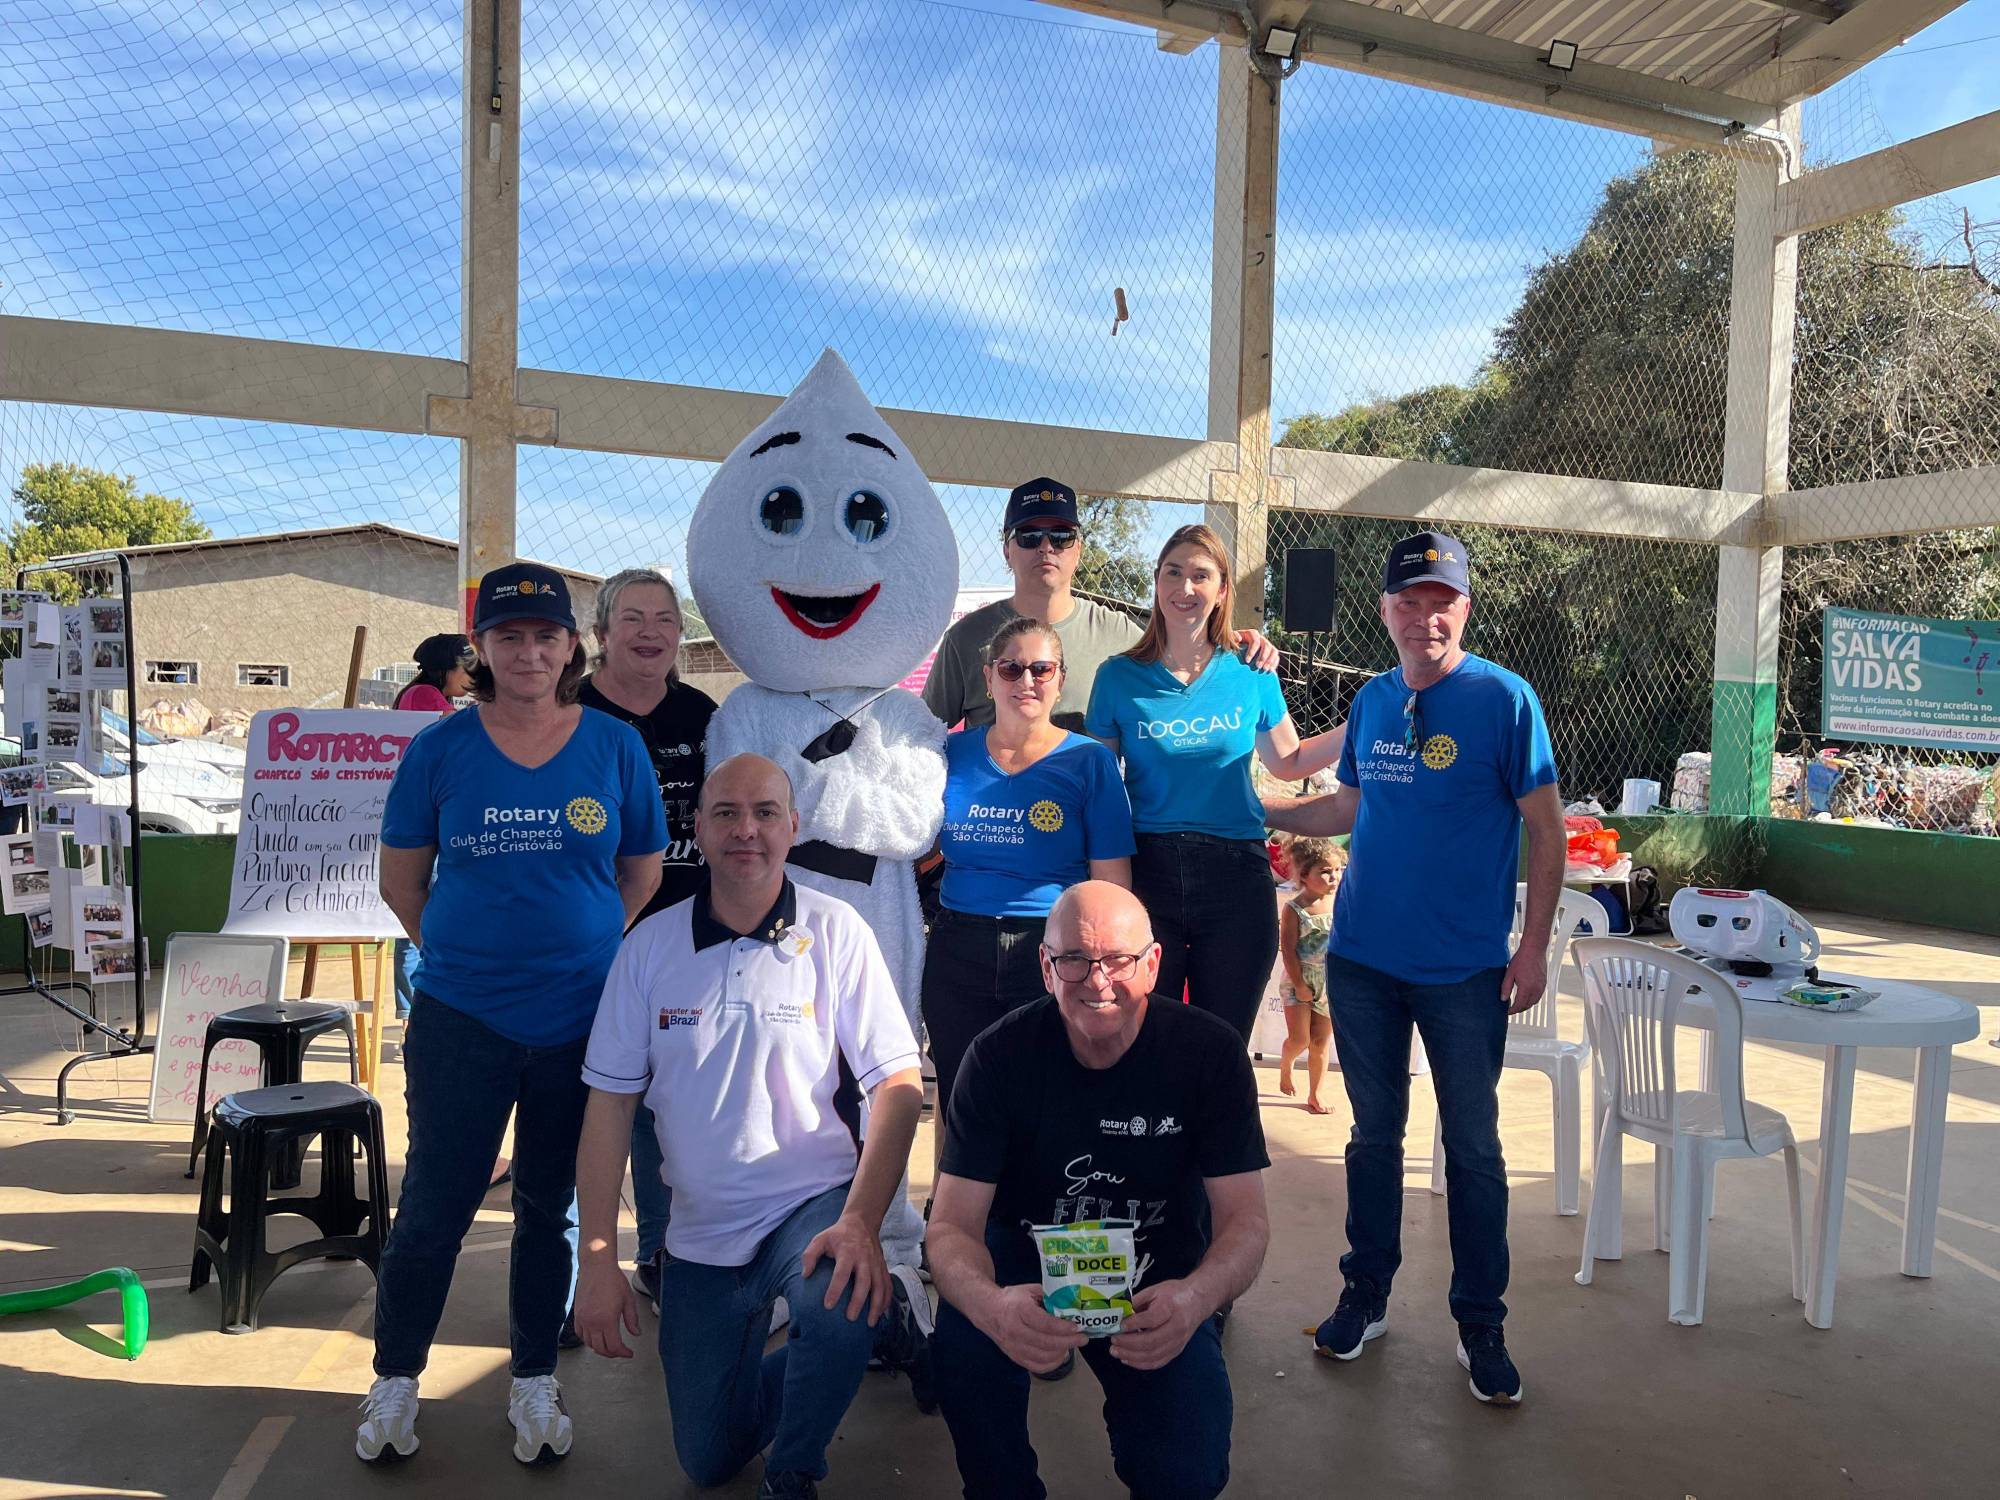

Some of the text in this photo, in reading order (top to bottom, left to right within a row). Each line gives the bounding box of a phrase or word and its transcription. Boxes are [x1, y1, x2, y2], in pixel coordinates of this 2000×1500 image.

[496, 583, 518, 594] Rotary
[1832, 630, 1920, 661] SALVA
[1832, 659, 1922, 692] VIDAS
[1830, 693, 1857, 703] Vacinas
[1861, 694, 1904, 705] funcionam.
[1906, 697, 1912, 706] O
[1914, 699, 1941, 710] Rotary
[1943, 701, 1979, 711] acredita
[1830, 703, 1852, 713] poder
[1854, 705, 1863, 713] da
[1865, 706, 1912, 718] informação
[1934, 711, 1970, 721] combate
[268, 712, 412, 763] ROTARACT
[1834, 721, 2000, 742] www.informacaosalvavidas.com.br
[1371, 740, 1417, 760] Rotary
[254, 767, 303, 780] CHAPECÓ
[311, 767, 330, 781] SÃO
[1366, 760, 1376, 769] de
[1376, 760, 1415, 773] Chapecó
[1360, 771, 1414, 784] São Cristóvão
[484, 806, 560, 825] Rotary
[967, 804, 1025, 822] Rotary
[246, 823, 299, 852] Ajuda
[304, 843, 322, 852] com
[326, 843, 342, 851] seu
[450, 826, 563, 848] Club de Chapecó
[943, 822, 1025, 835] Club de Chapecó
[952, 832, 1025, 844] São Cristóvão
[471, 840, 563, 857] São Cristóvão
[240, 852, 378, 883] Pintura facial
[239, 884, 279, 912] Zé
[178, 961, 270, 998] Venha
[670, 1014, 700, 1026] Brazil
[1100, 1119, 1129, 1130] Rotary
[1064, 1154, 1126, 1196] Sou
[1077, 1257, 1121, 1271] DOCE
